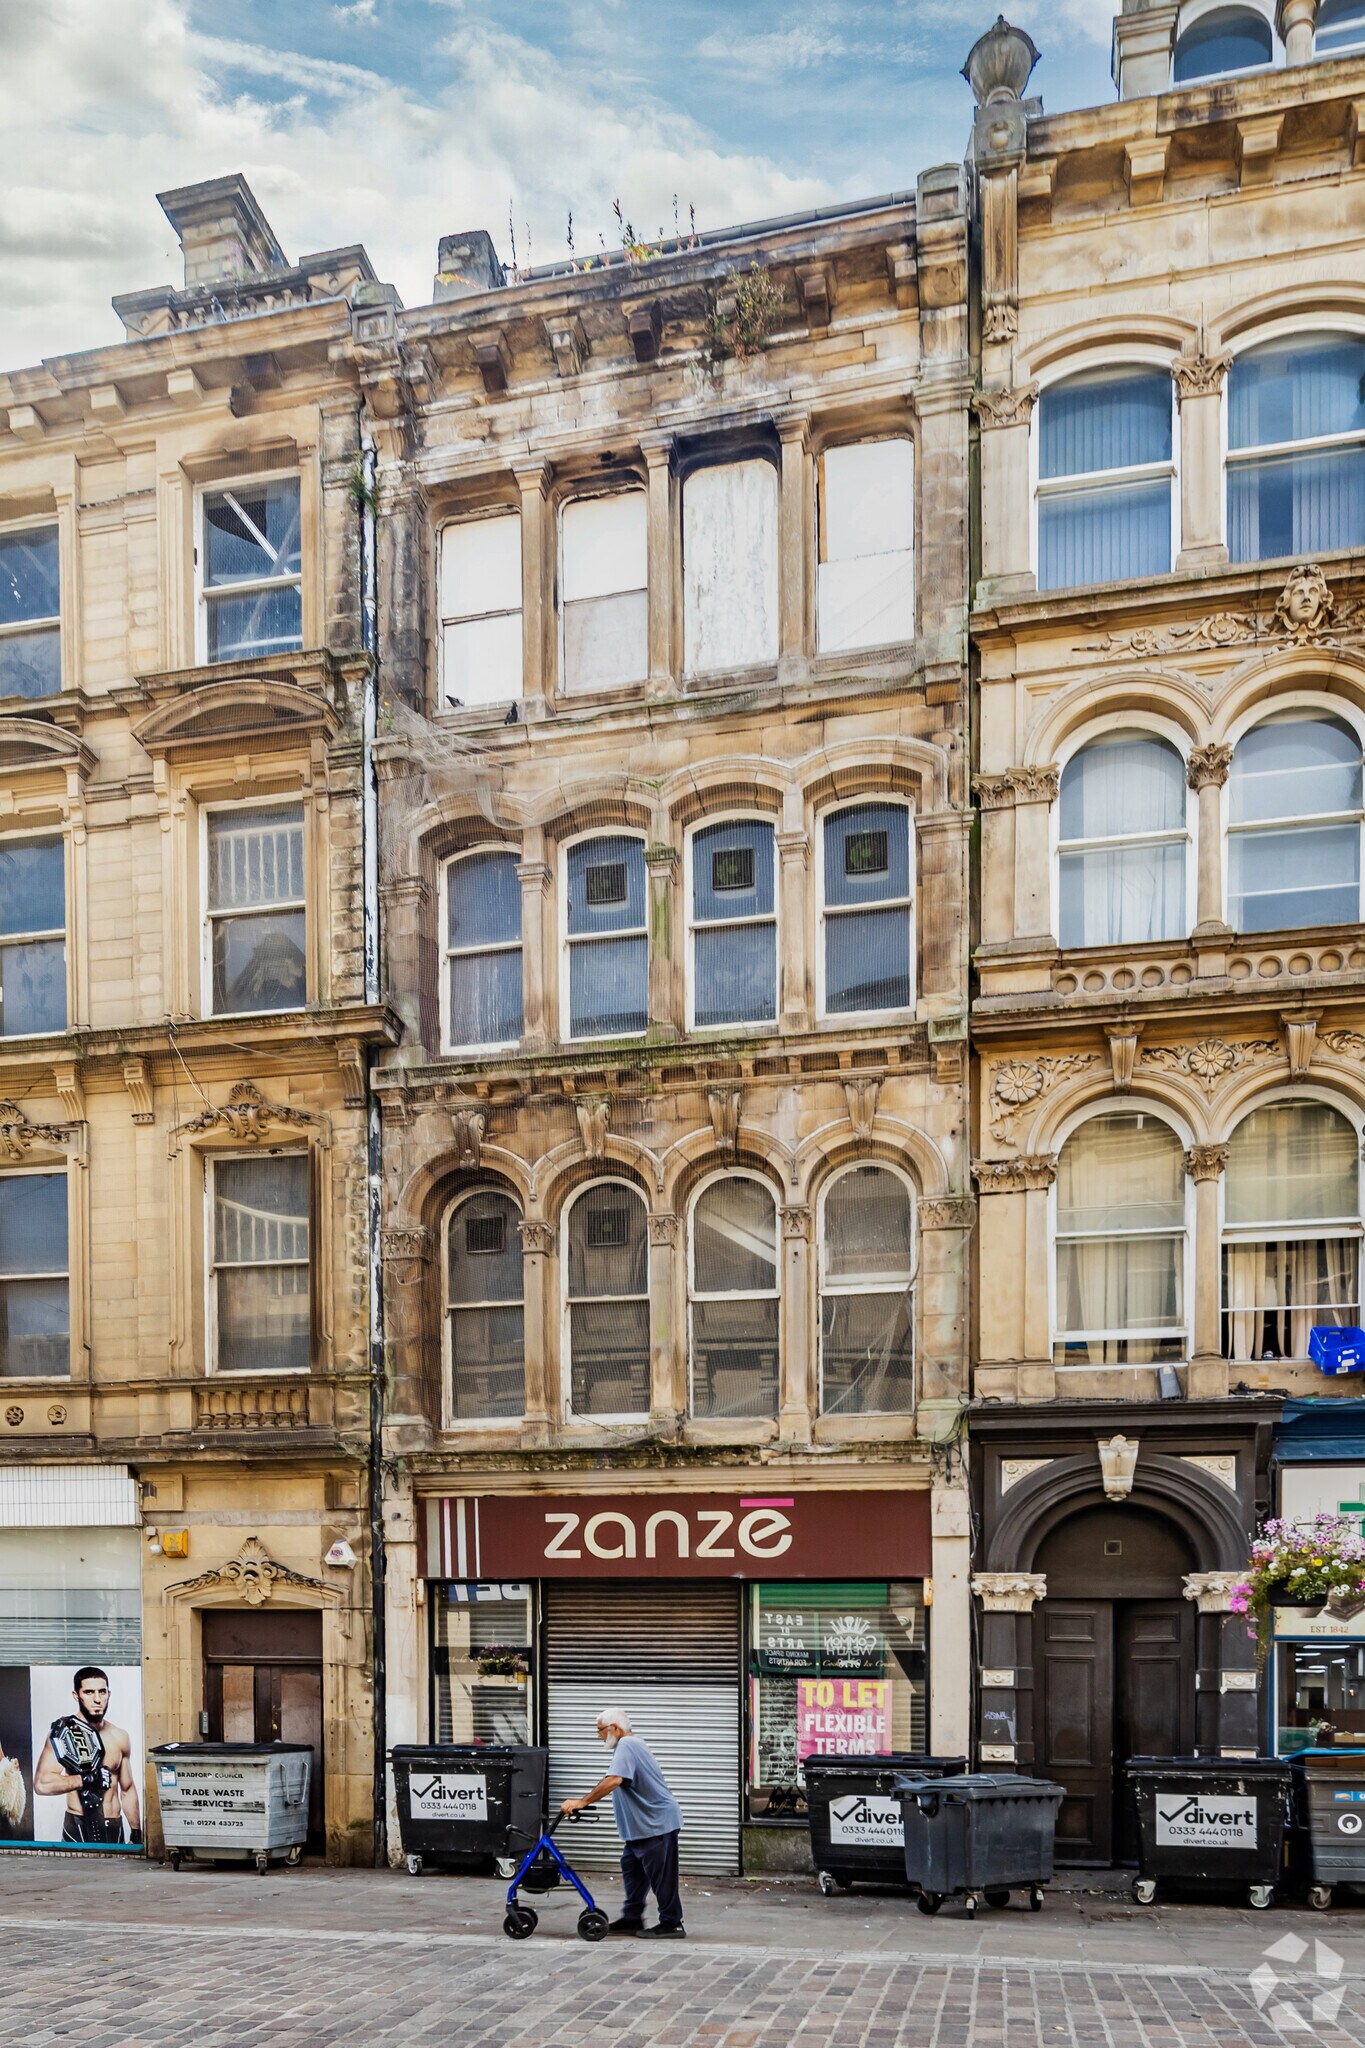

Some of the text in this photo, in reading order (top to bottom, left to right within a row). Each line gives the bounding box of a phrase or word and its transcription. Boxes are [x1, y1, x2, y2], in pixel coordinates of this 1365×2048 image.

[1310, 1625, 1349, 1633] EST 1842
[801, 1681, 889, 1708] TO LET
[805, 1713, 886, 1733] FLEXIBLE
[814, 1737, 876, 1755] TERMS
[101, 1768, 109, 1788] UFC
[180, 1788, 245, 1797] TRADE WASTE
[431, 1785, 484, 1800] divert
[192, 1800, 234, 1808] SERVICES
[420, 1802, 441, 1810] 0333
[1184, 1808, 1254, 1825] divert
[842, 1825, 866, 1834] 0333
[1169, 1826, 1196, 1835] 0333
[1183, 1838, 1229, 1846] divert.co.uk
